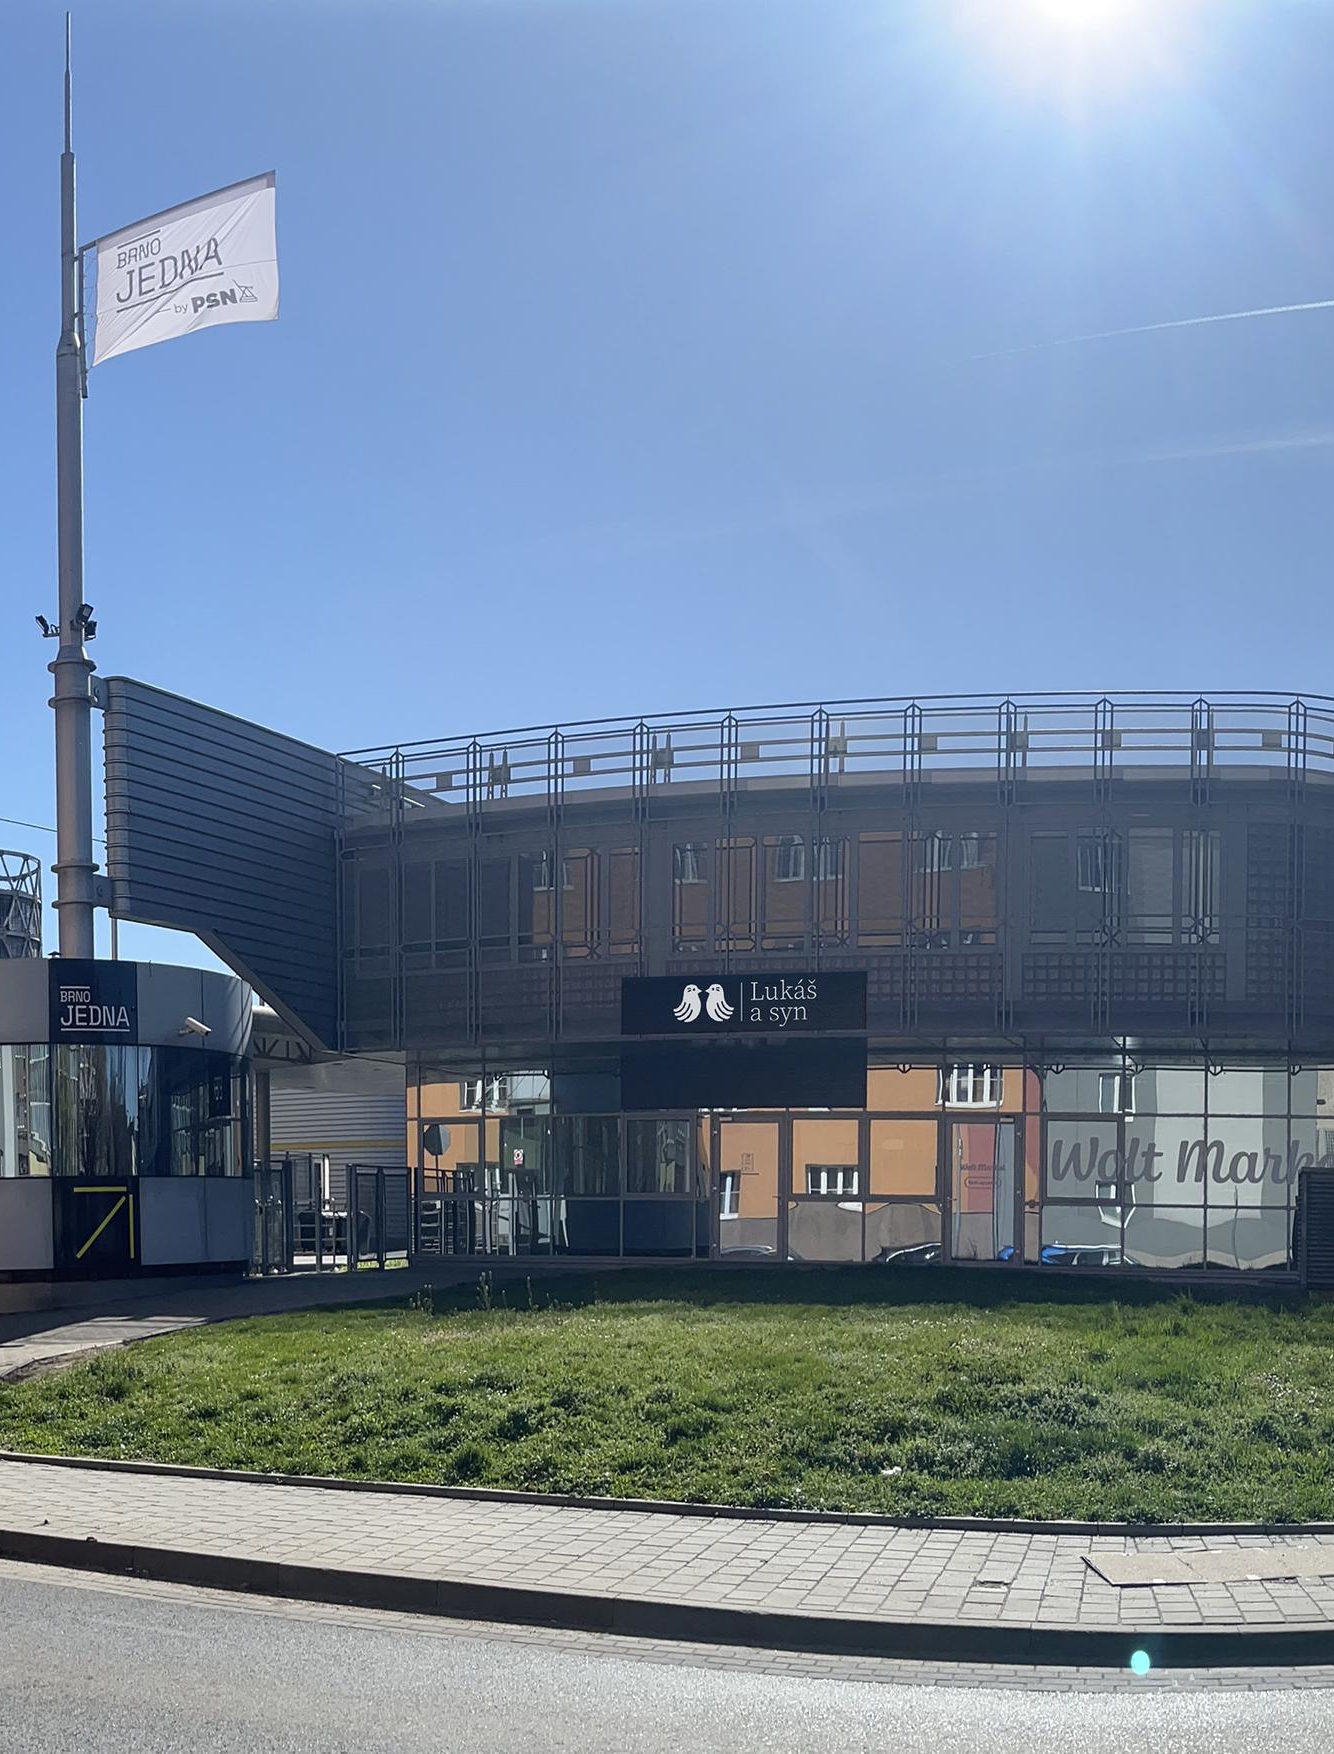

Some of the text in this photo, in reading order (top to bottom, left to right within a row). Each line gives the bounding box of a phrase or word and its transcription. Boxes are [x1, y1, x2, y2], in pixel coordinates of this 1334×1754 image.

[117, 238, 161, 269] BRNO
[116, 237, 223, 303] JEDNA
[174, 288, 238, 314] by PSN
[60, 990, 91, 1002] BRNO
[750, 979, 817, 1001] Lukáš
[60, 1005, 130, 1027] JEDNA
[750, 1003, 808, 1027] a syn
[1051, 1136, 1164, 1183] Wolt
